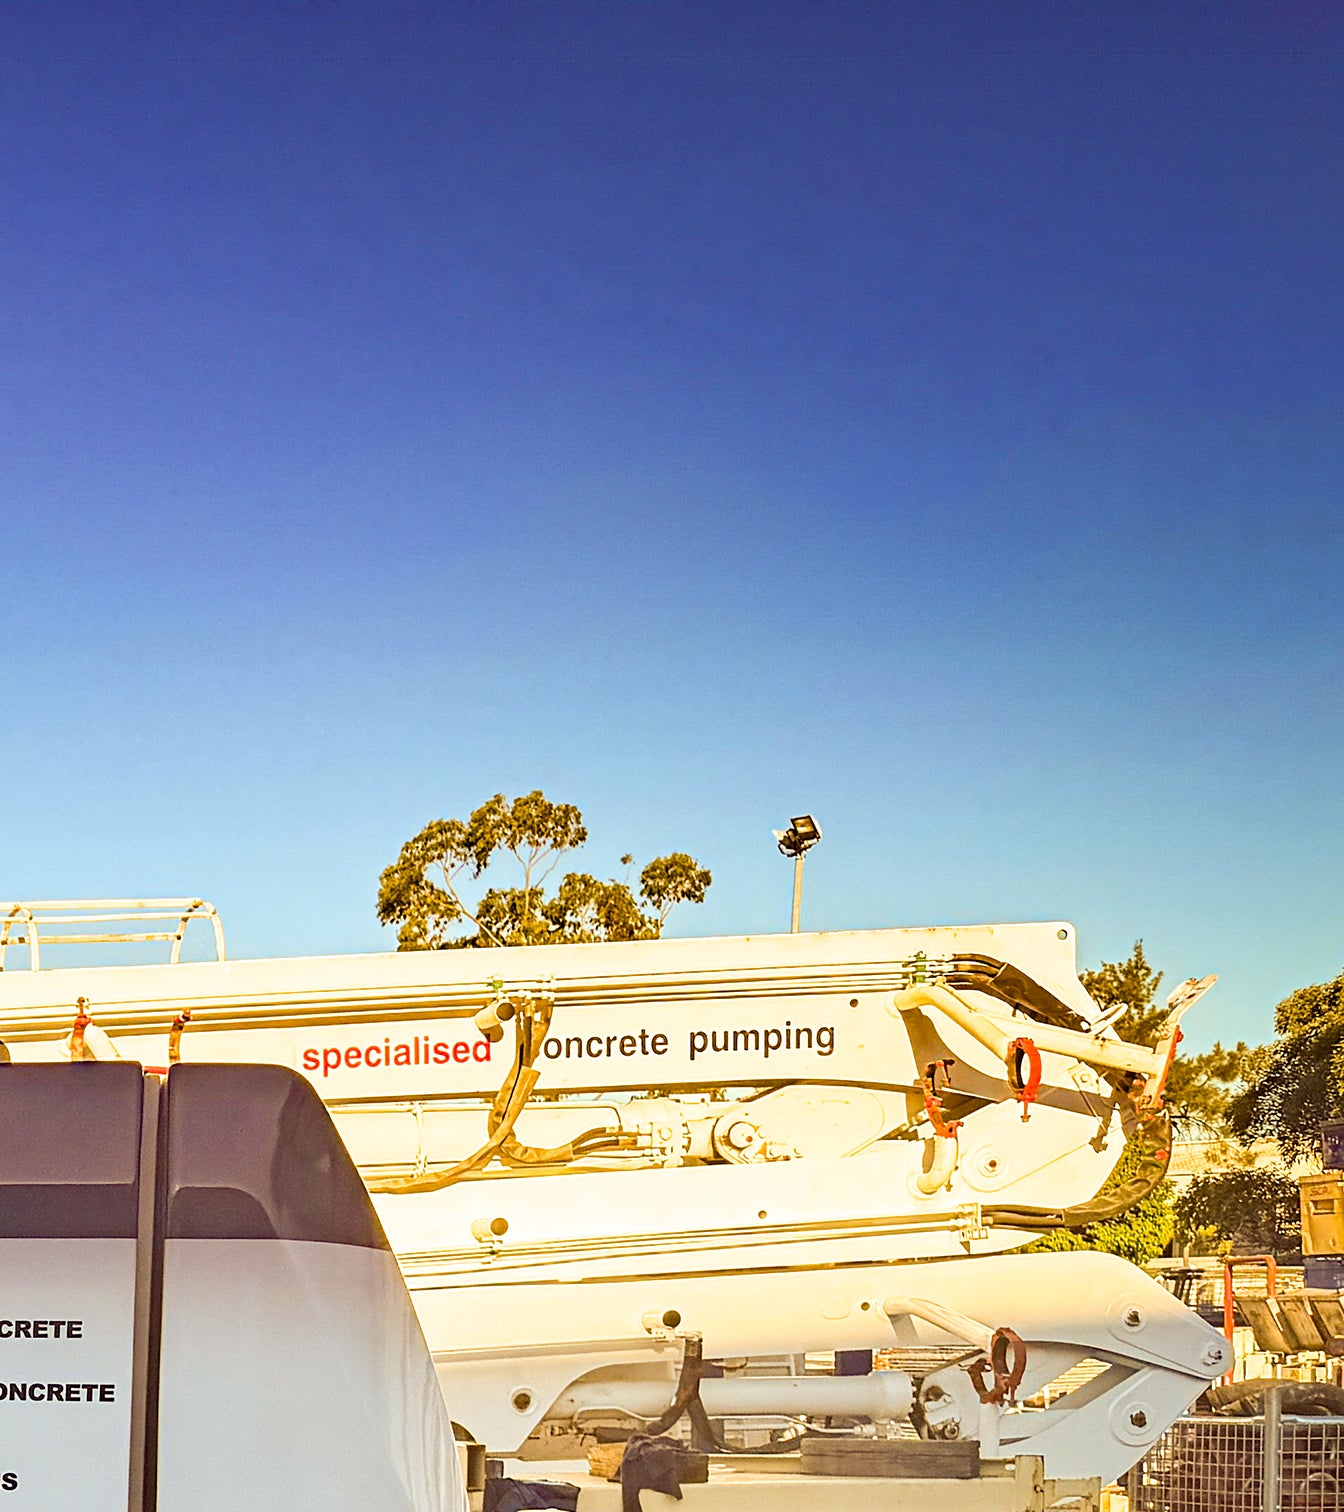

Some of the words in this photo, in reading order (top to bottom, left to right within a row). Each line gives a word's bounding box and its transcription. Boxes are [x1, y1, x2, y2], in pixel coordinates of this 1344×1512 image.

[302, 1036, 492, 1078] specialised
[543, 1026, 669, 1060] oncrete
[689, 1021, 836, 1061] pumping
